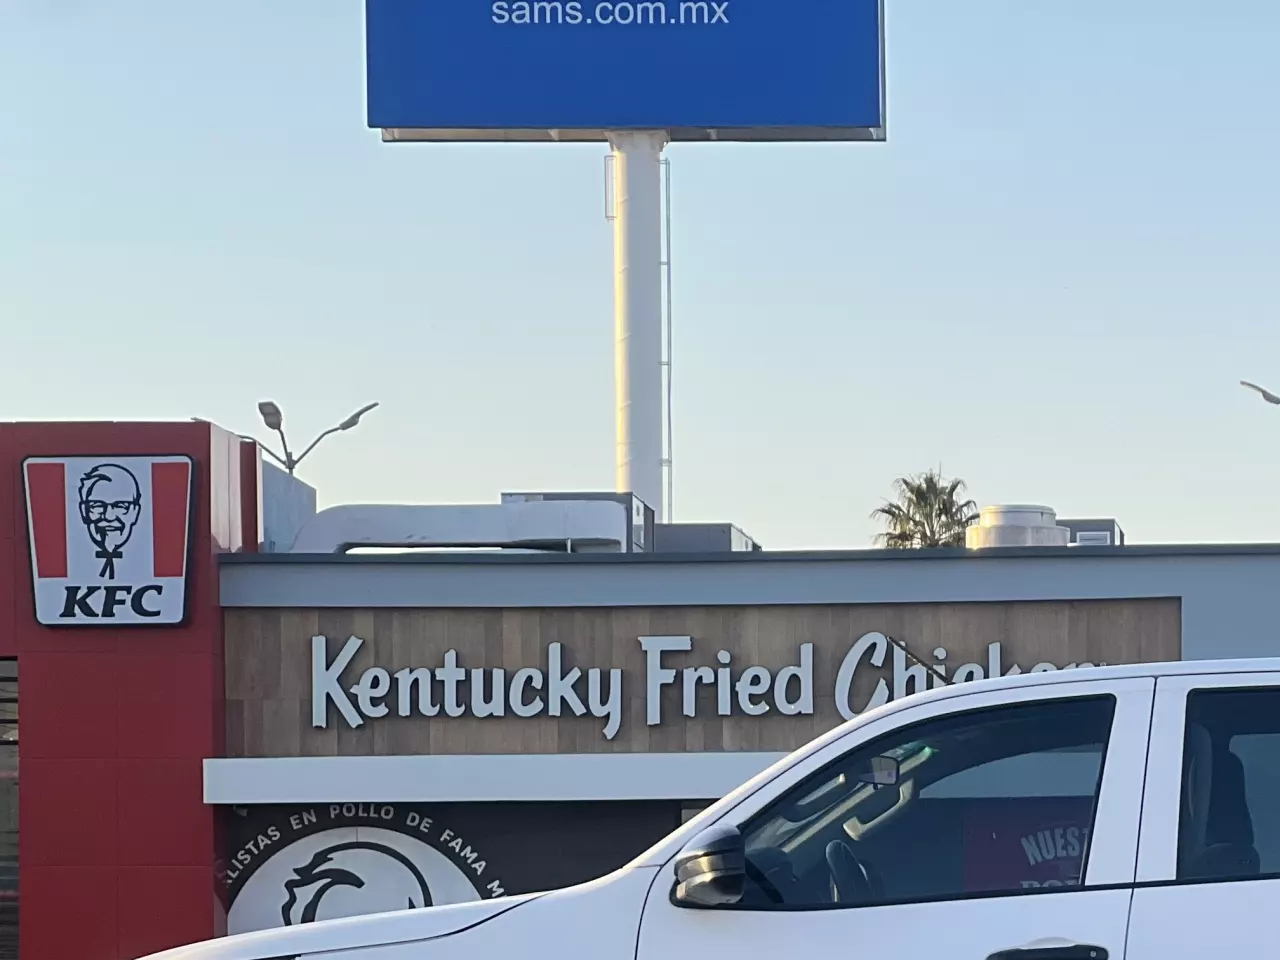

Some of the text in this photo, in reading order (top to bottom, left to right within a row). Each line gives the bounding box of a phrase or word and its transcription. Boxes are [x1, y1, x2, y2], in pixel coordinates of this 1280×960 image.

[491, 0, 730, 25] sams.com.mx
[58, 584, 164, 618] KFC
[311, 634, 622, 741] Kentucky
[637, 635, 815, 727] Fried
[289, 809, 318, 830] EN
[329, 802, 395, 820] POLLO
[406, 812, 434, 833] DE
[440, 828, 487, 876] FAMA
